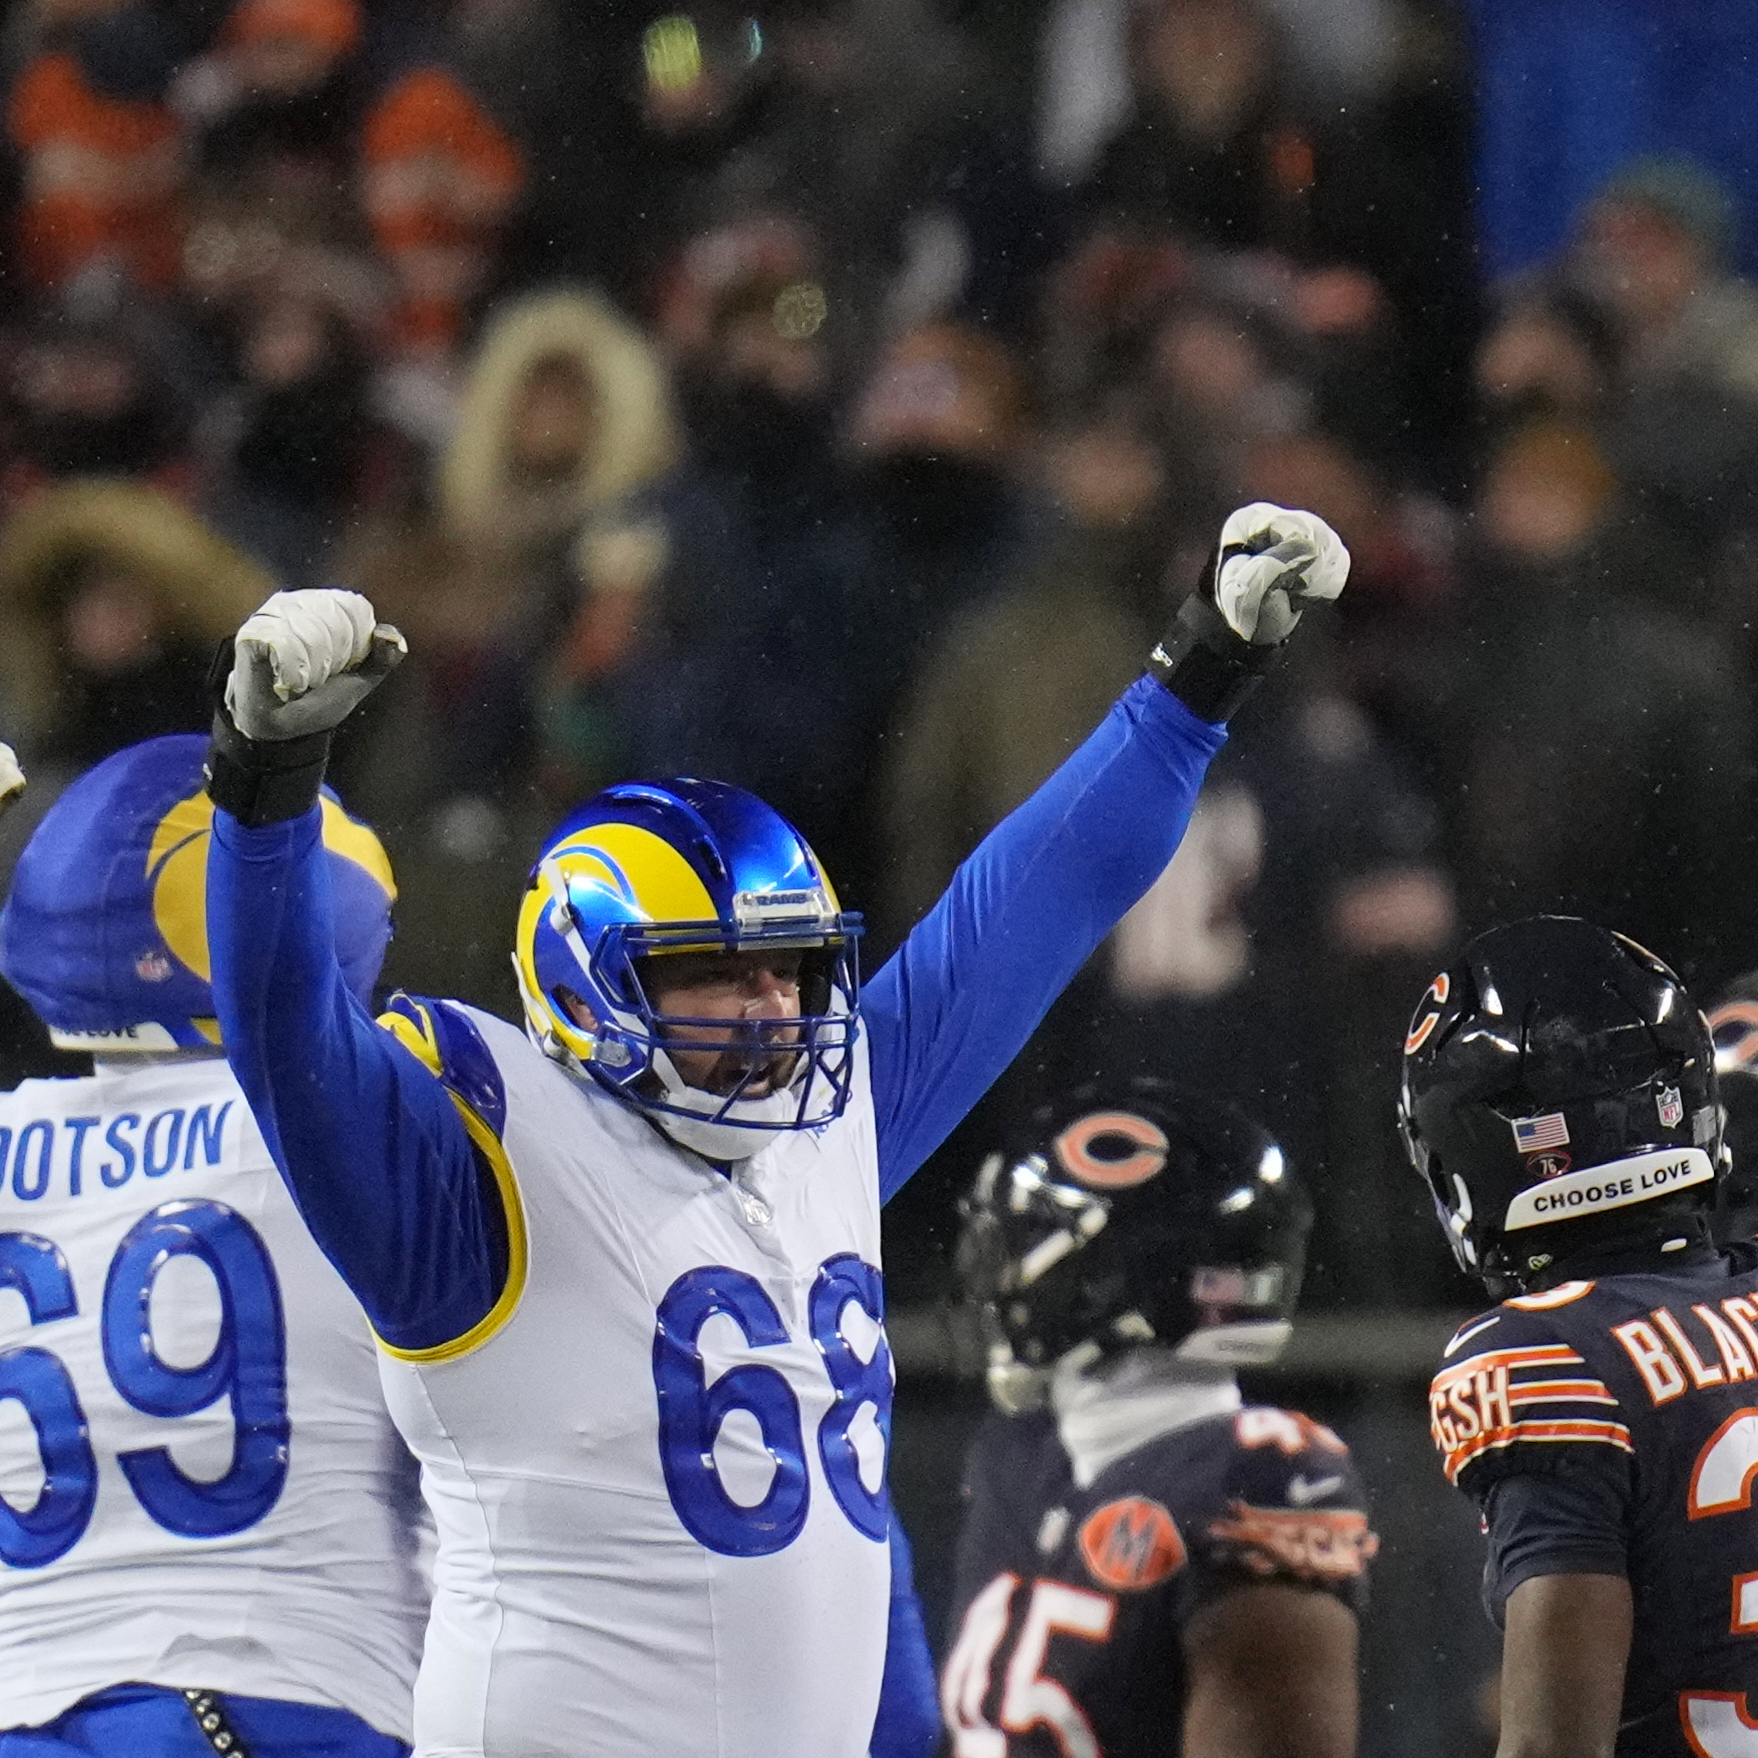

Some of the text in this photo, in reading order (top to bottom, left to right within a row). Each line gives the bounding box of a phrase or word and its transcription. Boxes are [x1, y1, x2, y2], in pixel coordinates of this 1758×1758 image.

[0, 1099, 236, 1203] OTSON
[1534, 1159, 1692, 1212] CHOOSE LOVE
[0, 1197, 291, 1568] 69
[652, 1252, 893, 1557] 68
